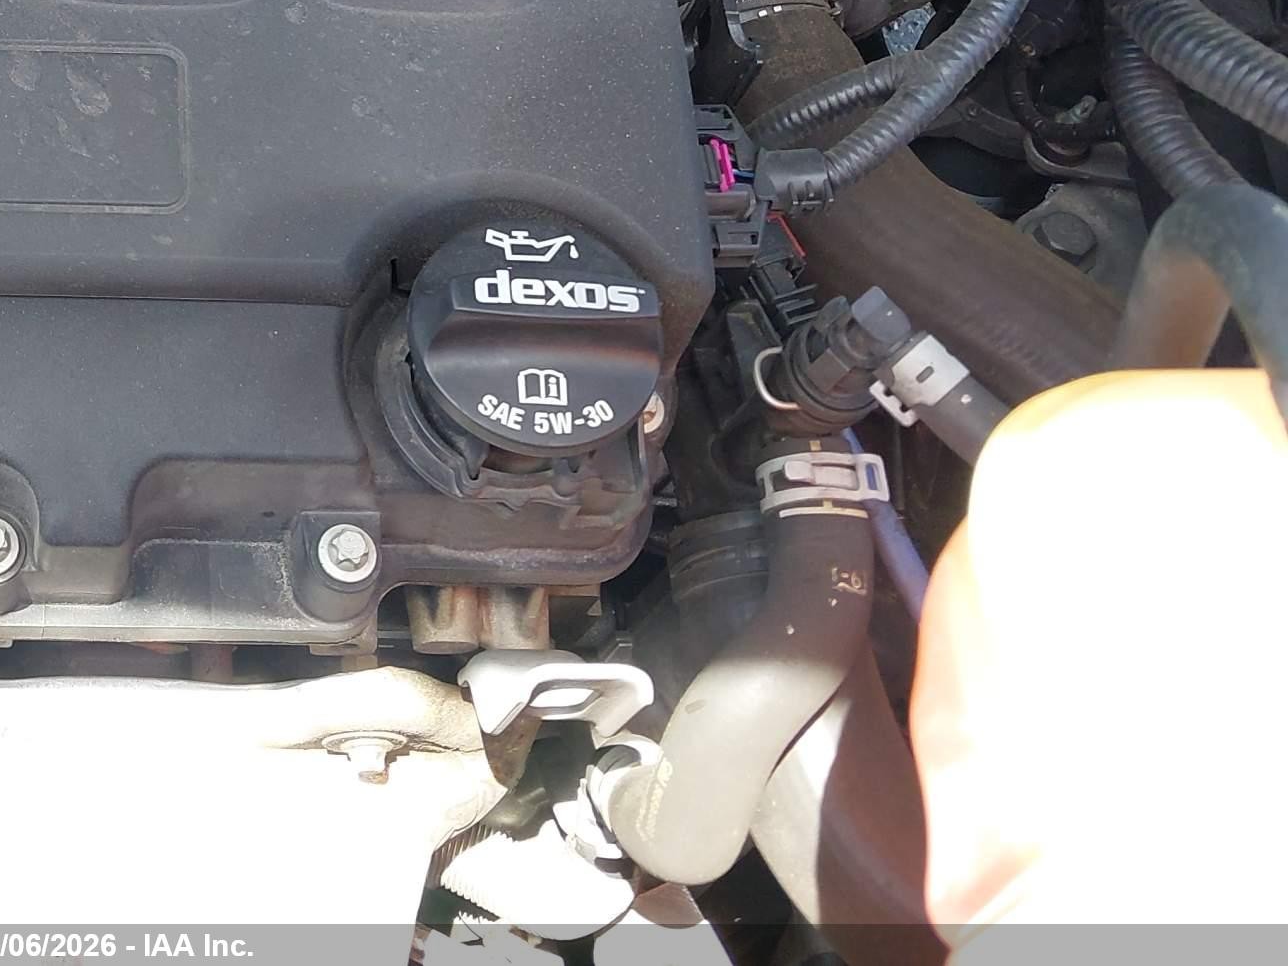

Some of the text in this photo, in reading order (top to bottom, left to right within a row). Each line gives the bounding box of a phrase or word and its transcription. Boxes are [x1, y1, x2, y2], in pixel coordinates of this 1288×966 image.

[474, 269, 640, 313] dexos
[477, 393, 614, 435] SAE 5W-30
